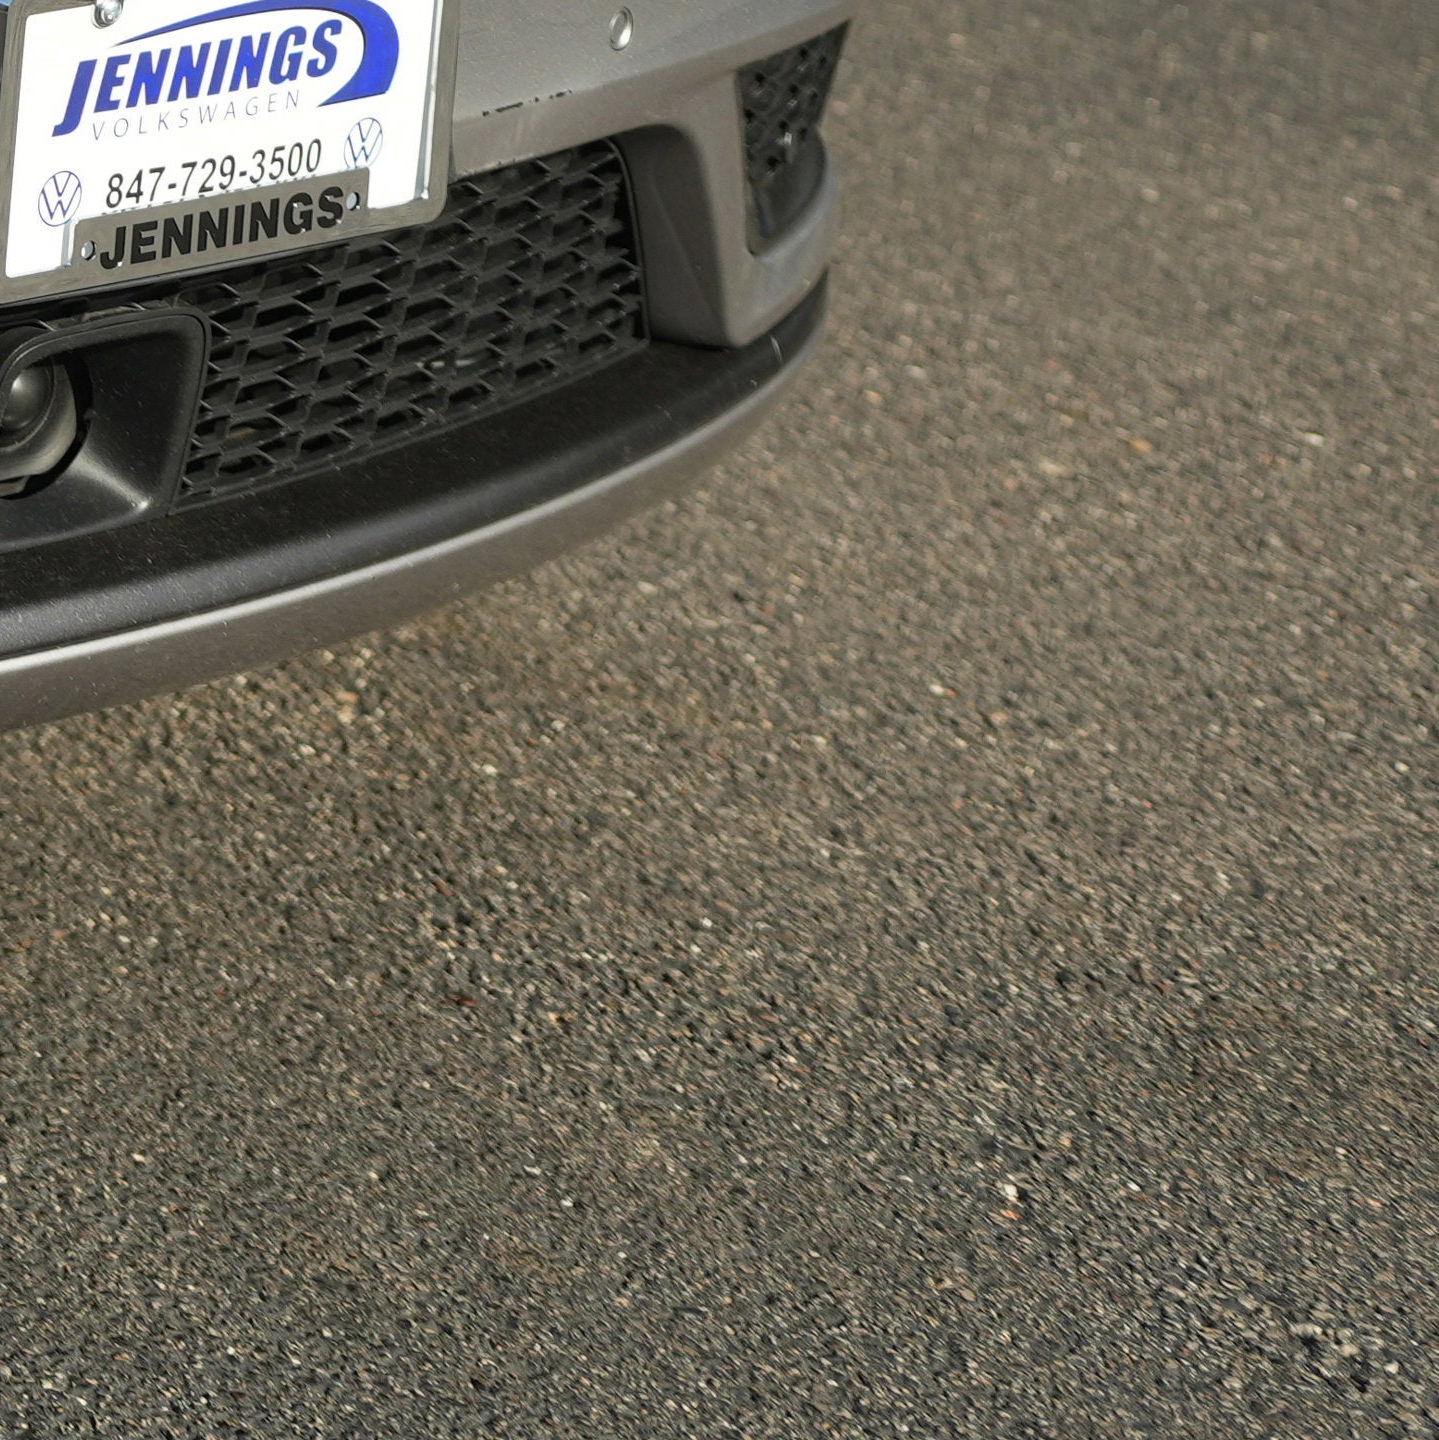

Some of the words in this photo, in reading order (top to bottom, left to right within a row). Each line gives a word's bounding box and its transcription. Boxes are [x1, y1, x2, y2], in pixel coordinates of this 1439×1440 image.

[52, 19, 343, 137] JENNINGS
[92, 90, 301, 141] VOLKSWAGEN
[106, 138, 322, 208] 847-729-3500
[100, 186, 344, 269] JENNINGS
